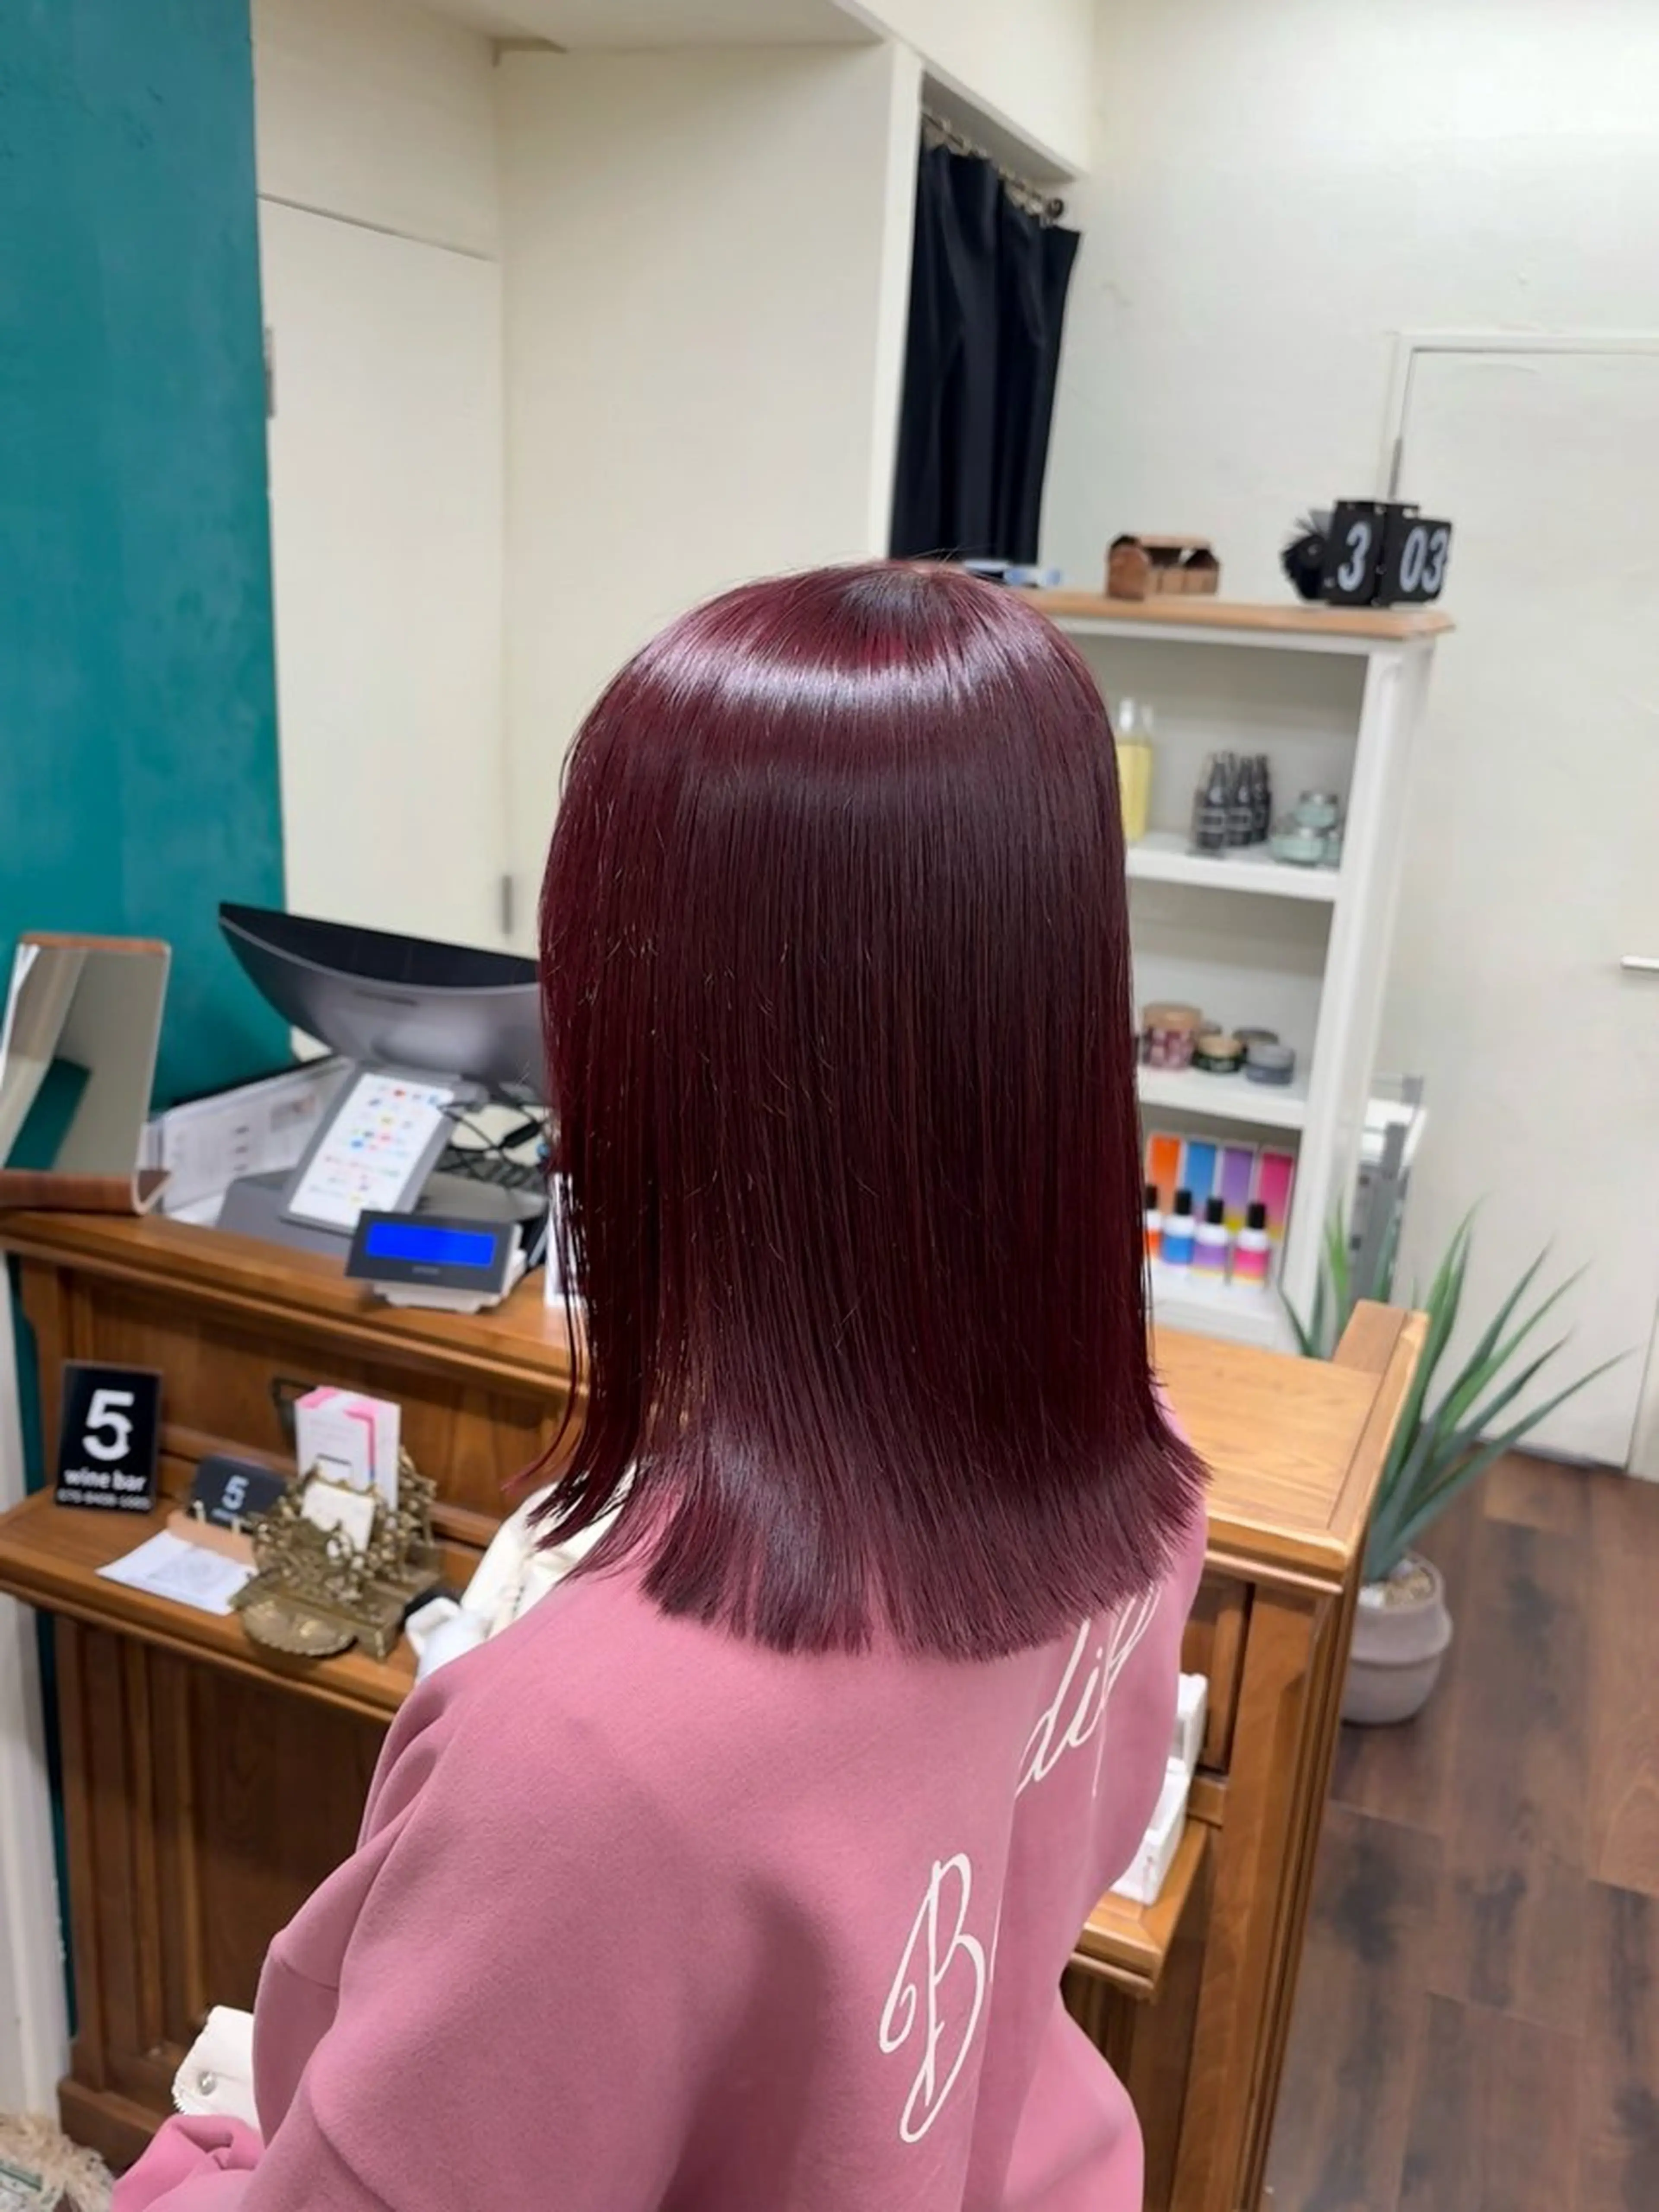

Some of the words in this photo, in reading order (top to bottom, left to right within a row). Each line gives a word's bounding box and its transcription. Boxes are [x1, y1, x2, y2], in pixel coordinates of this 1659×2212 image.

[1338, 521, 1371, 592] 3
[1399, 525, 1449, 594] 03
[82, 1389, 135, 1461] 5
[64, 1467, 111, 1489] wine
[113, 1469, 146, 1492] bar
[222, 1475, 250, 1510] 5
